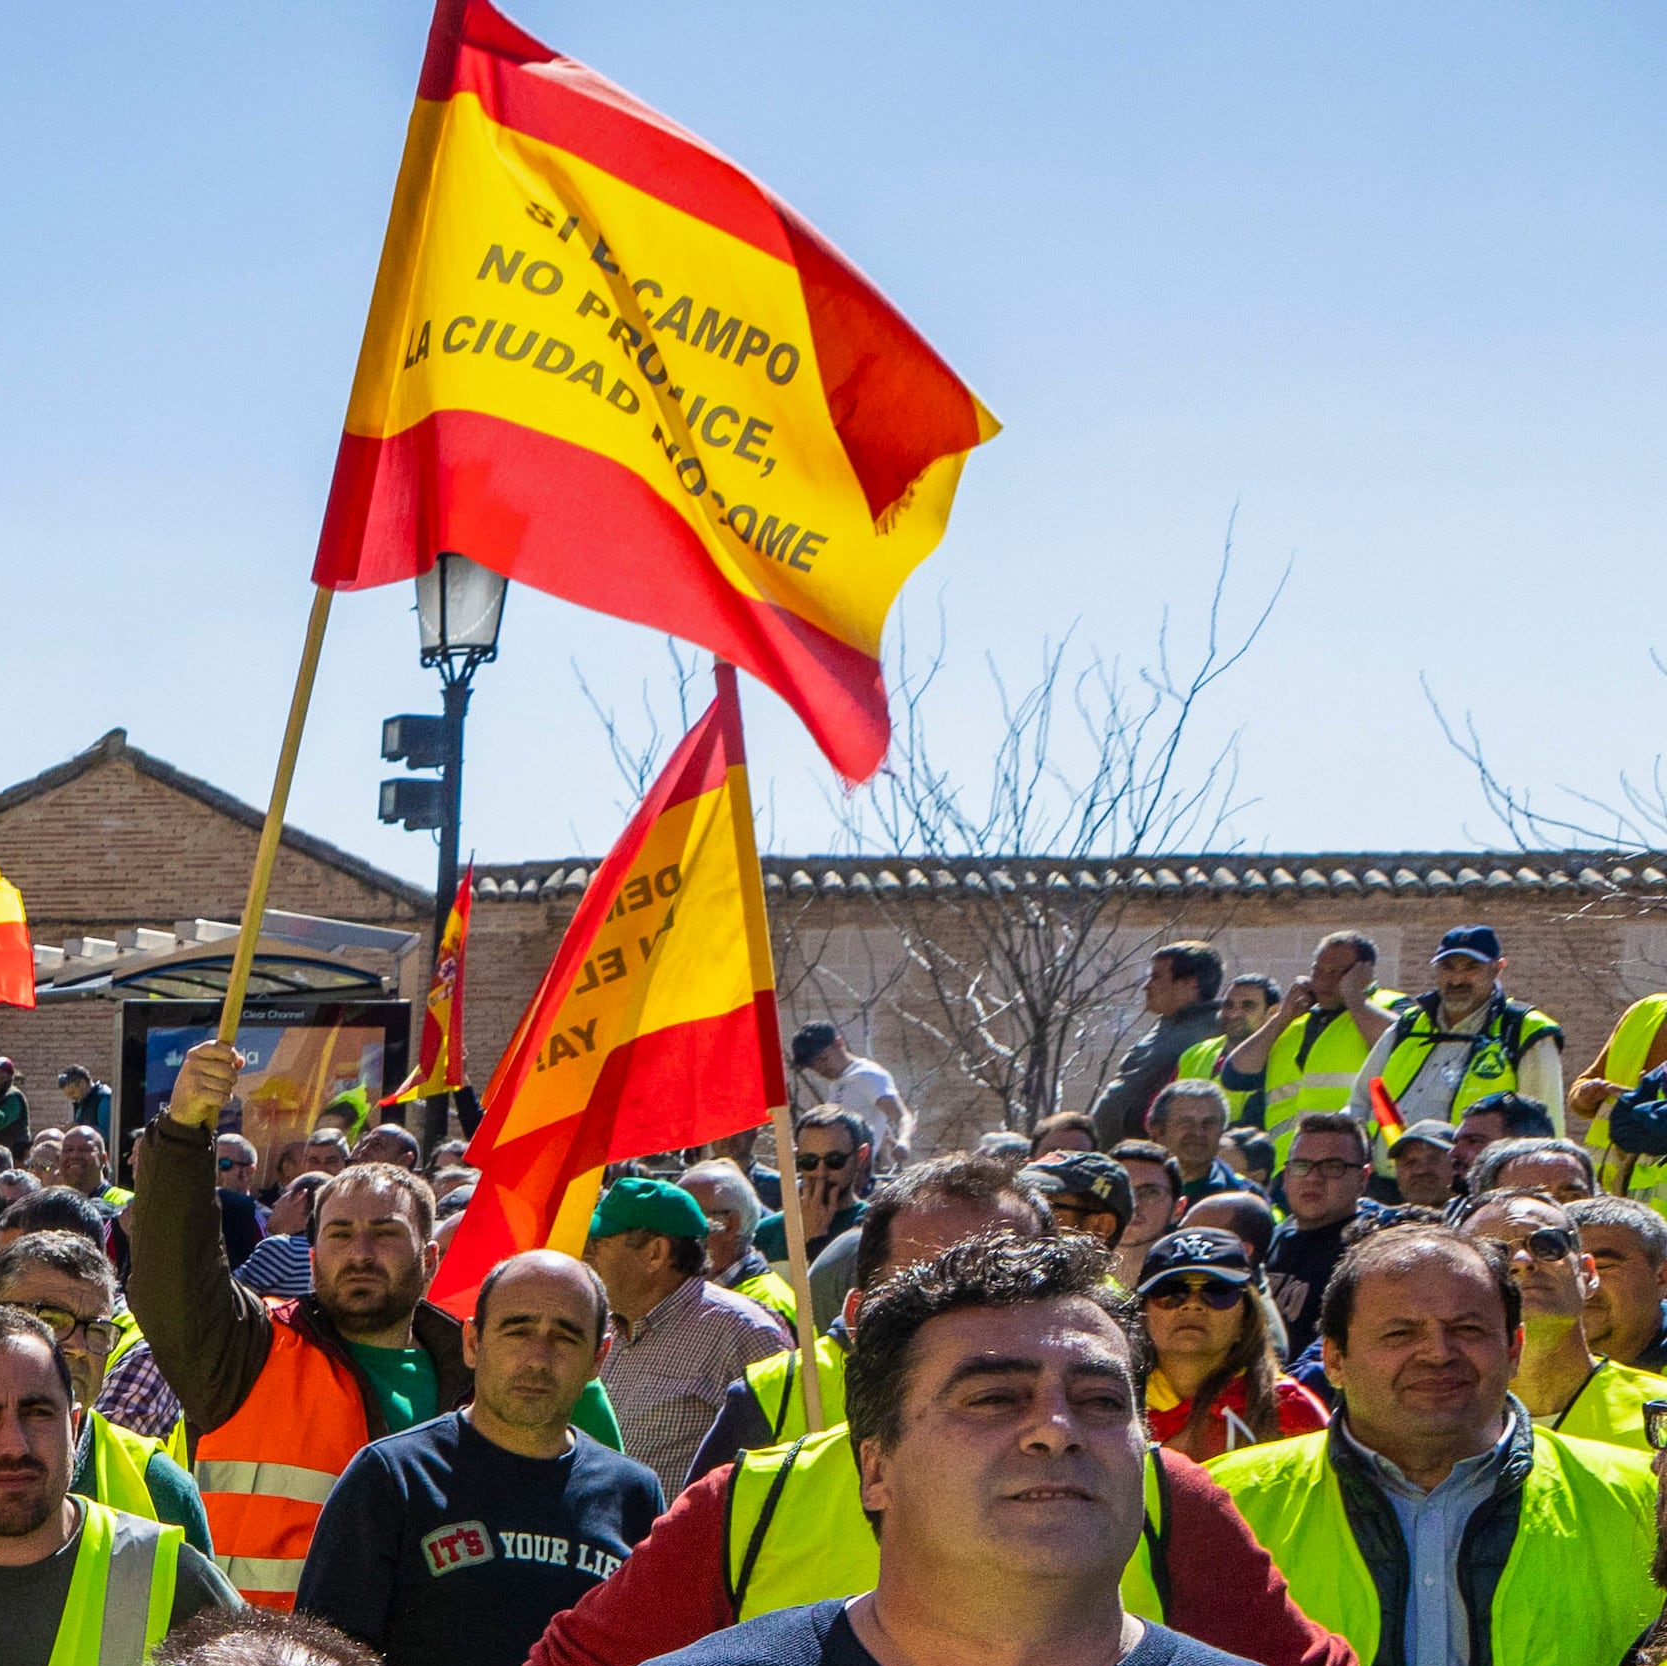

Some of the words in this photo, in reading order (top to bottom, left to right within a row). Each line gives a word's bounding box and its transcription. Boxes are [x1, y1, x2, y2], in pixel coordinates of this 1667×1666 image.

[476, 244, 564, 297] NO
[575, 288, 779, 479] PROCE,
[525, 201, 580, 243] SI
[631, 278, 800, 386] CAMPO
[403, 319, 432, 371] LA
[442, 315, 641, 415] CIUDAD
[427, 1527, 486, 1569] IT'S
[498, 1531, 569, 1566] YOUR
[575, 1543, 623, 1581] LIF
